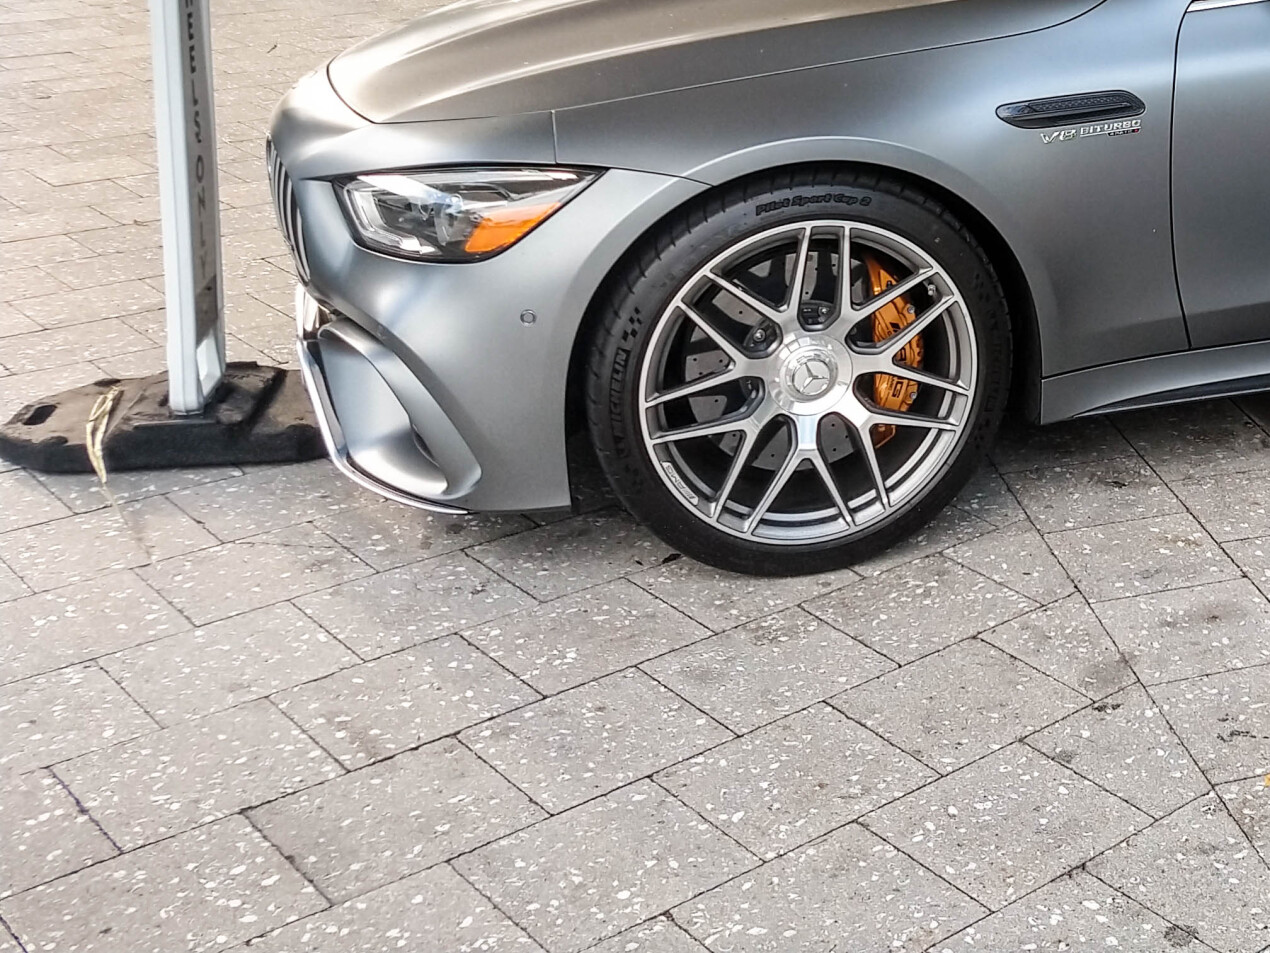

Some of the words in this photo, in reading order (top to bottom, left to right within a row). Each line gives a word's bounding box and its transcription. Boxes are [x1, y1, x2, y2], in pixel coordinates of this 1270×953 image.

[1040, 128, 1078, 144] V8
[1080, 119, 1141, 136] BITURBO
[196, 154, 207, 280] ONLY
[756, 197, 790, 217] Pilot
[791, 194, 832, 207] Sport
[833, 193, 859, 206] Cup
[859, 196, 873, 207] 2
[608, 347, 632, 439] MICHELIN
